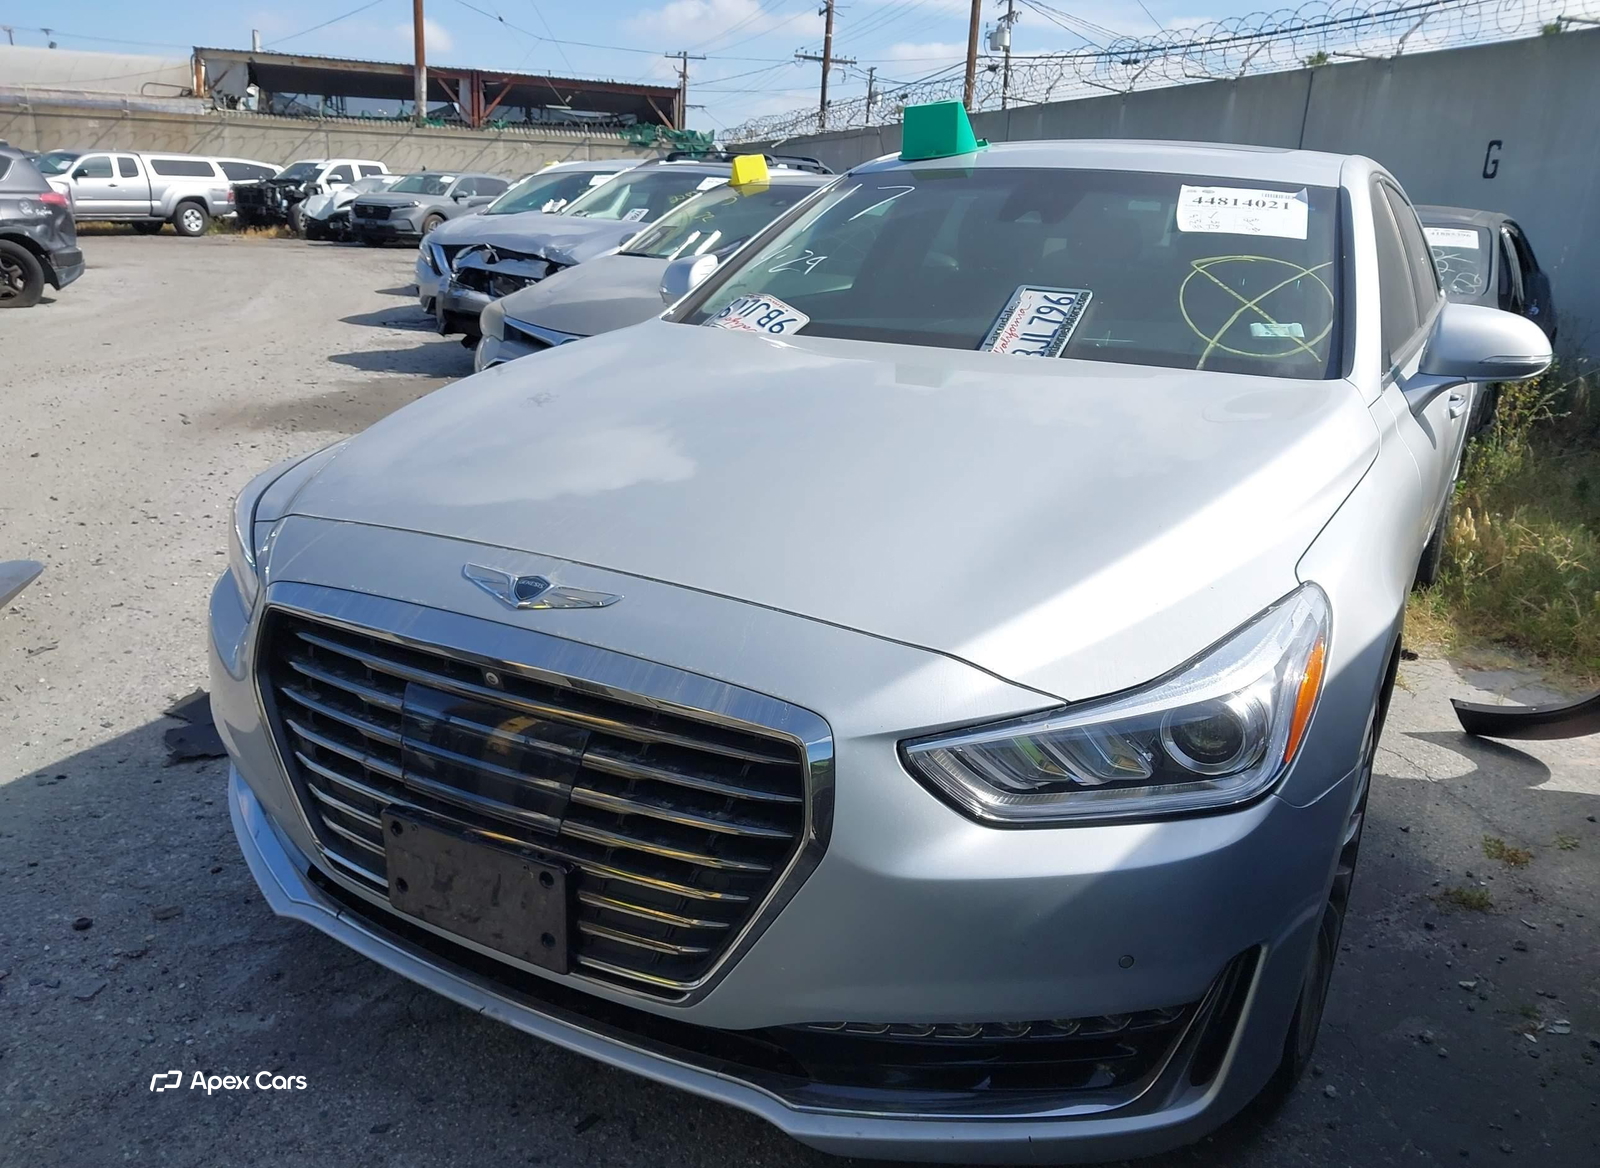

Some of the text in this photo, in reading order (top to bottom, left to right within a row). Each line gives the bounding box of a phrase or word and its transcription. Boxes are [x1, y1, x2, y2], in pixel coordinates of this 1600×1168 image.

[1482, 139, 1502, 179] G
[1192, 196, 1290, 210] 44814021
[518, 580, 545, 589] GENESIS
